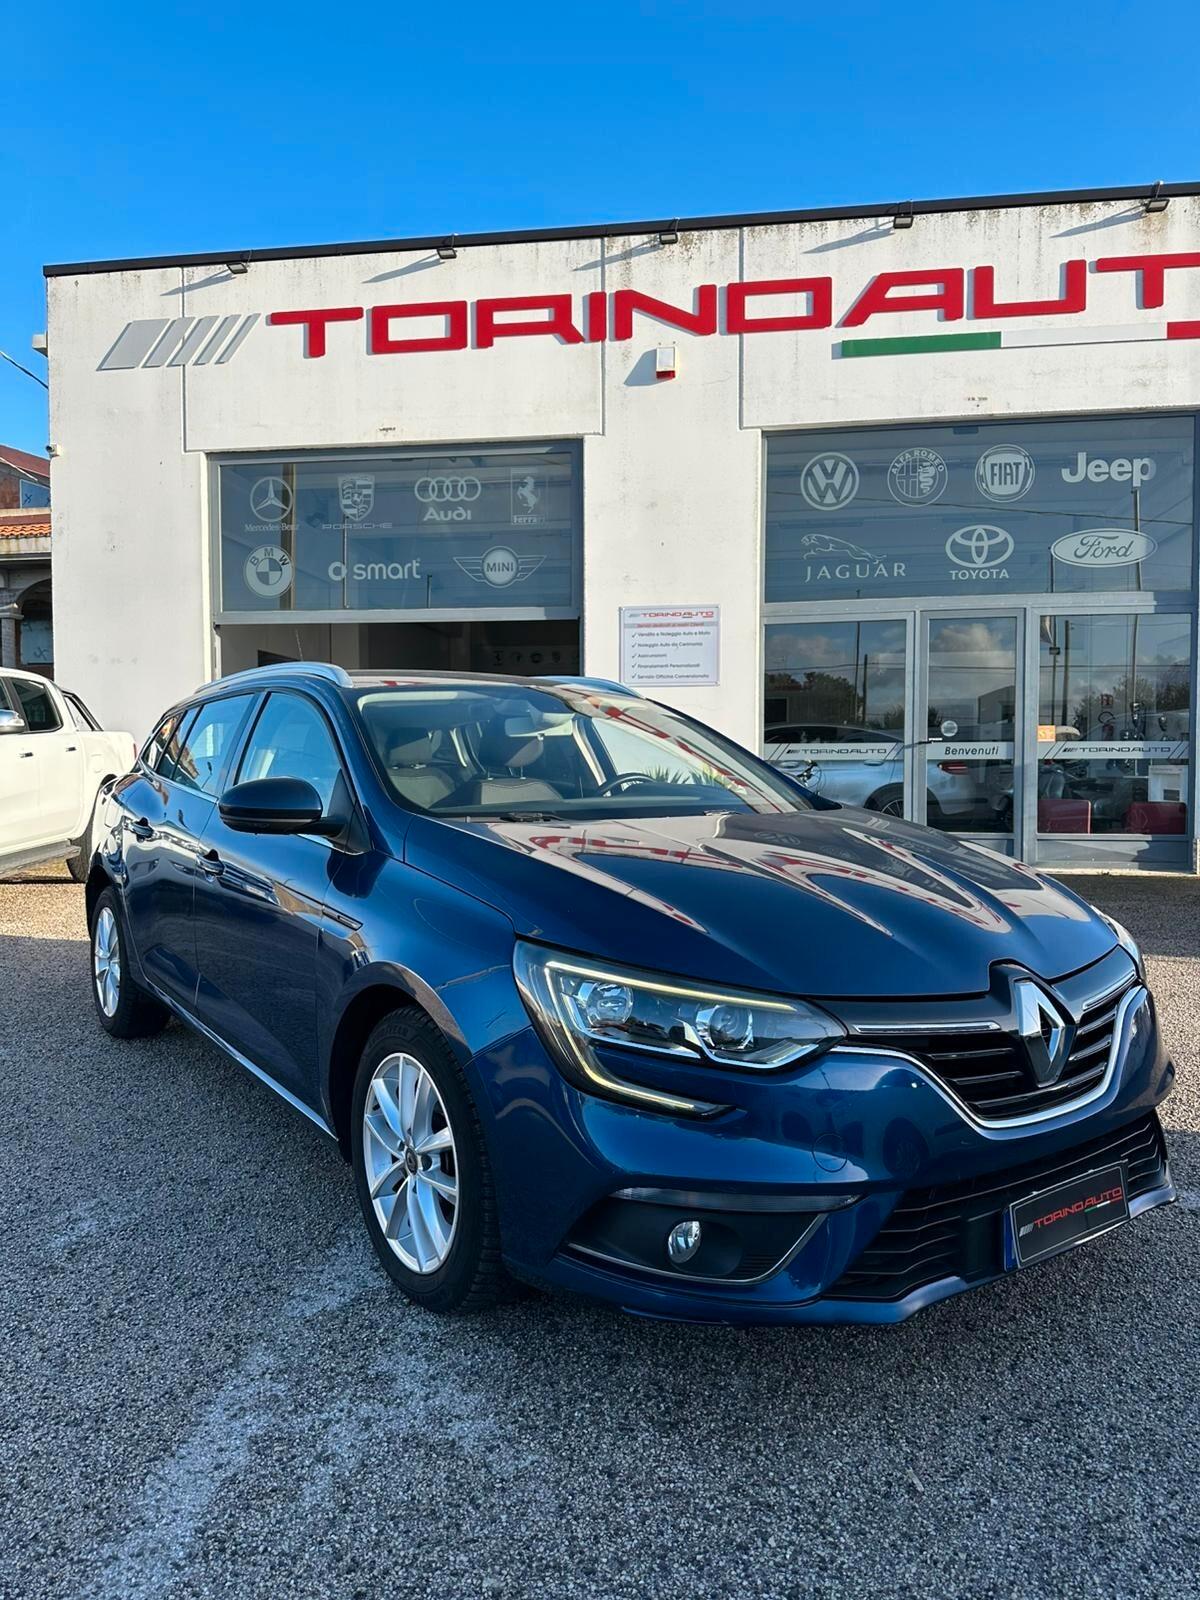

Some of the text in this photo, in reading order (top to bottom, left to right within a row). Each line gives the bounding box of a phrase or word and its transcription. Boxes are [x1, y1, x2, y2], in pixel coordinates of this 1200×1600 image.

[891, 450, 945, 475] ALFA ROMEO
[1061, 452, 1157, 487] Jeep
[990, 461, 1023, 486] FIAT
[423, 507, 472, 521] Audi
[322, 522, 393, 530] PORSCHE
[250, 548, 290, 567] BMW
[1074, 535, 1134, 559] Ford
[353, 559, 421, 581] smart
[486, 562, 514, 573] MINI
[805, 562, 906, 583] JAGUAR
[950, 568, 1009, 580] TOYOTA
[944, 746, 999, 755] Benvenuti
[1034, 1188, 1122, 1228] TORINOAUTO
